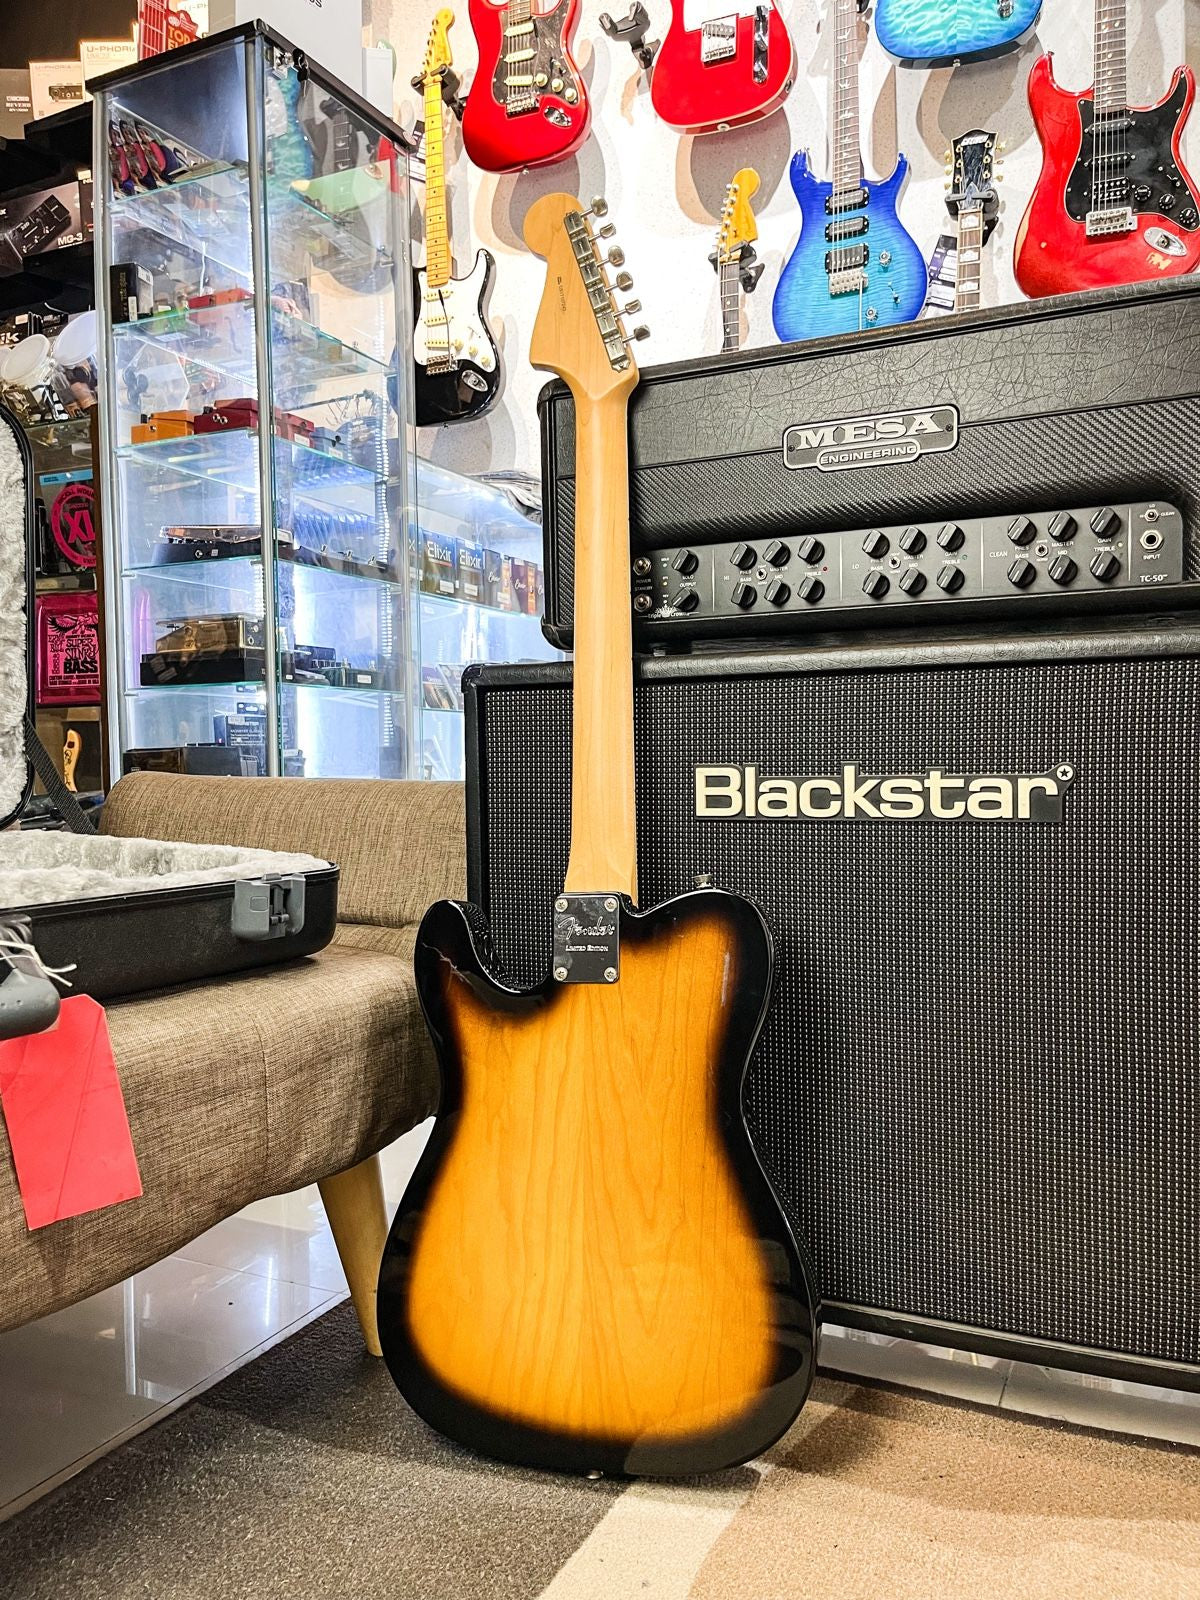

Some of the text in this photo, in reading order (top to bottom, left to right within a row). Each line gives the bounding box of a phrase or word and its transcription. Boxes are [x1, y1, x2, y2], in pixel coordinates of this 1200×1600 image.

[57, 232, 83, 246] MG-3
[796, 413, 944, 450] MESA
[820, 445, 917, 465] ENGINEERING
[426, 540, 452, 562] Elixir
[459, 548, 482, 569] Elixir
[1140, 573, 1163, 583] TC-50
[66, 638, 93, 648] SUPER
[63, 660, 98, 674] BASS
[695, 765, 1059, 818] Blackstar
